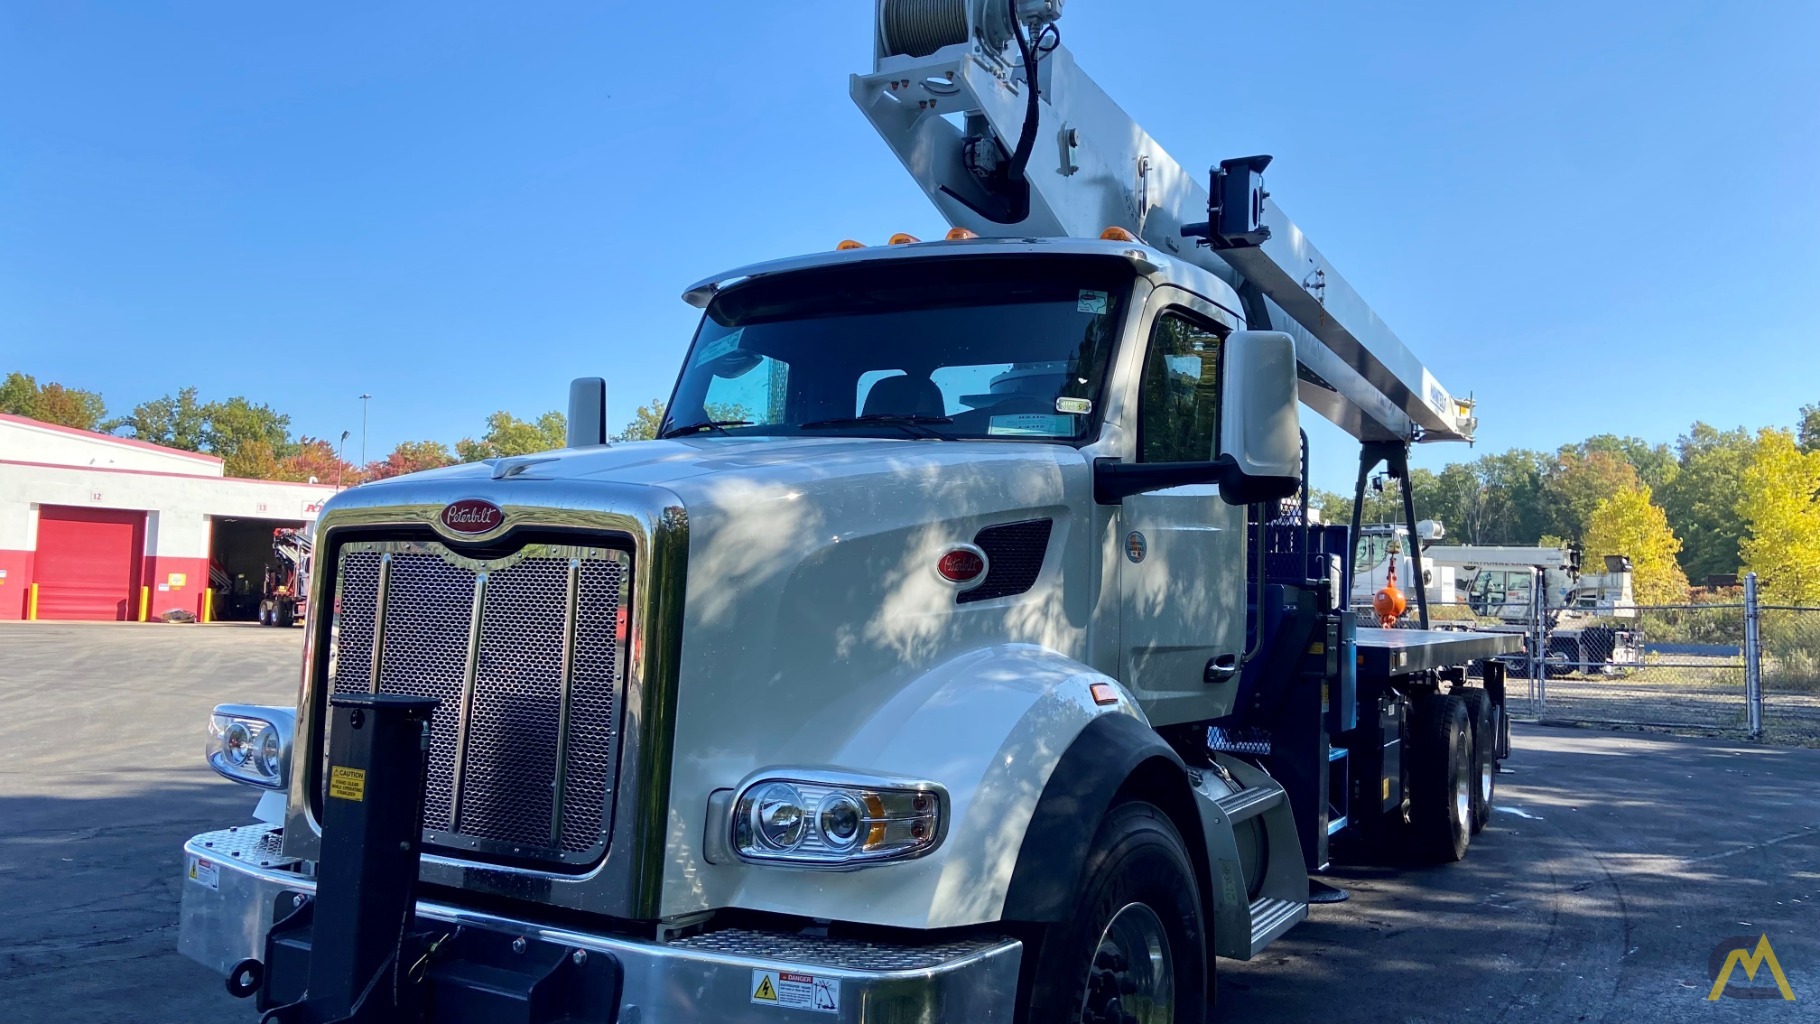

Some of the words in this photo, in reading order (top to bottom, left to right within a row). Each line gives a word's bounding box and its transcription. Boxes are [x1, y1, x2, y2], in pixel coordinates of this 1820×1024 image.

[446, 505, 497, 525] Peterbilt
[340, 769, 364, 778] CAUTION
[788, 974, 811, 982] DANGER
